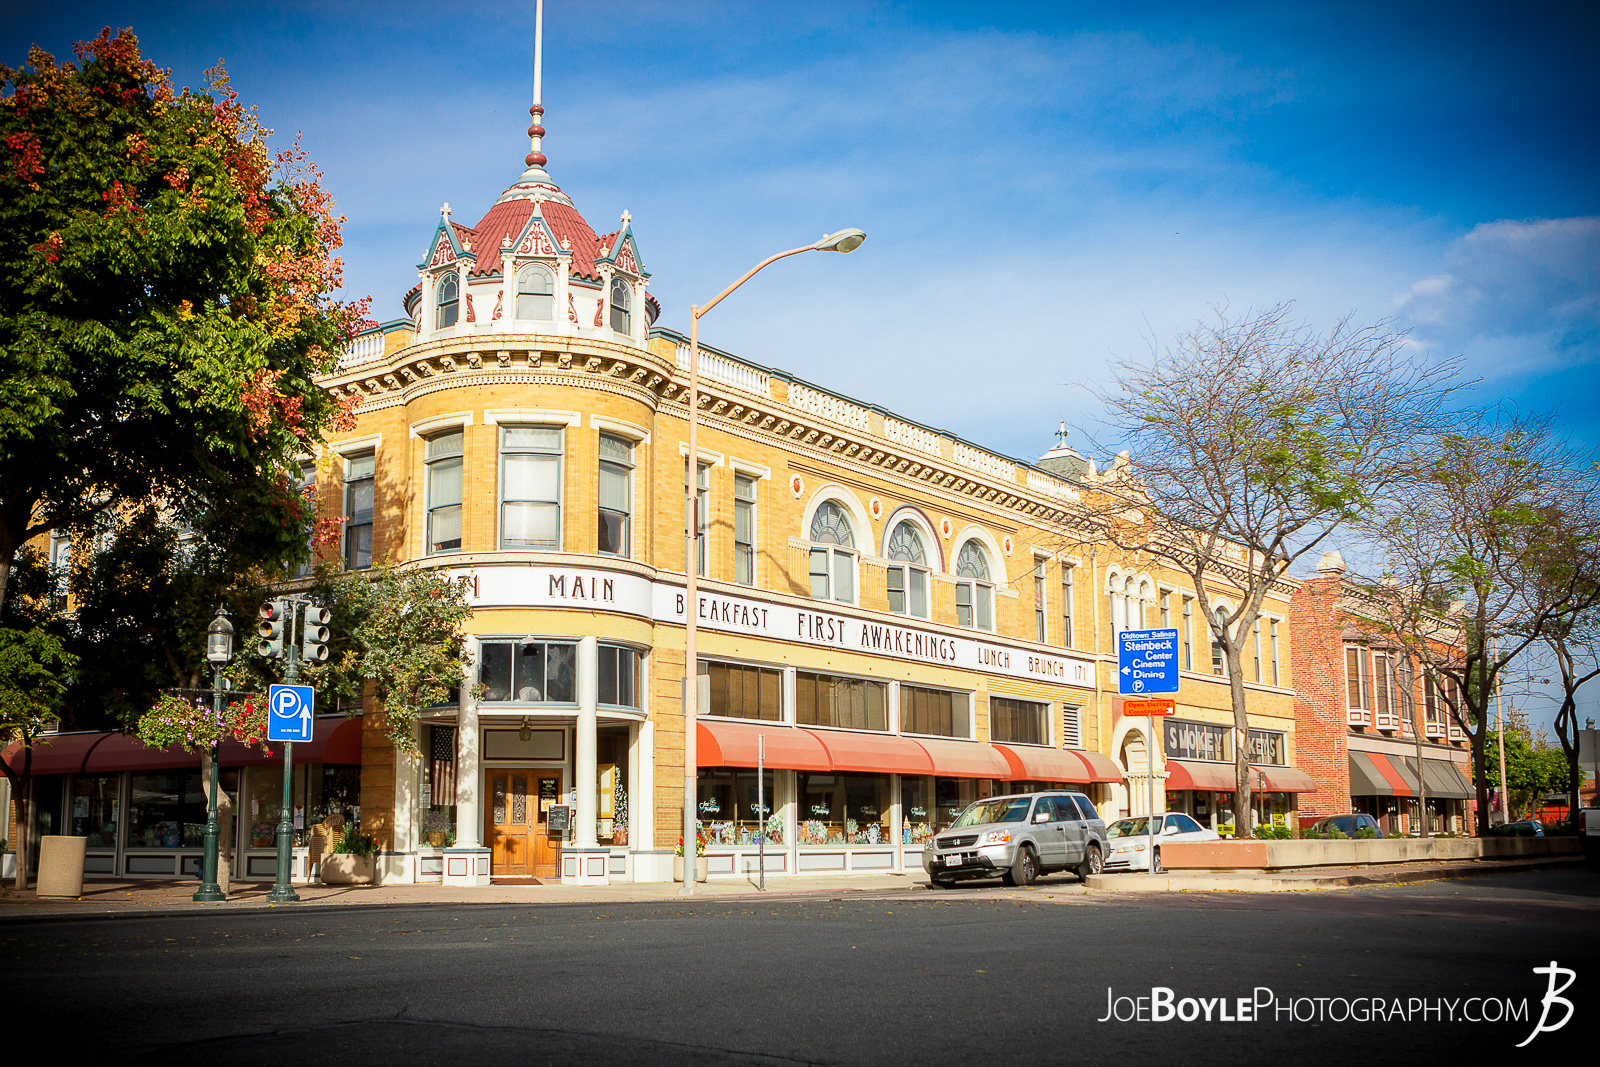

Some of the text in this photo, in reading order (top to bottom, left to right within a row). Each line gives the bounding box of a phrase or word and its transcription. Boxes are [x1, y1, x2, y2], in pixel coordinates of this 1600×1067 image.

[549, 574, 614, 602] MAIN
[676, 593, 1086, 681] BEAKFAST FIRST AWAKENINGS LUNCH BRUNCH 171
[1125, 640, 1172, 651] Steinbeck
[1145, 651, 1173, 660] Center
[1132, 659, 1165, 668] Cinema
[1133, 670, 1165, 679] Dining
[279, 693, 296, 713] P
[1169, 727, 1222, 752] SMOKEY
